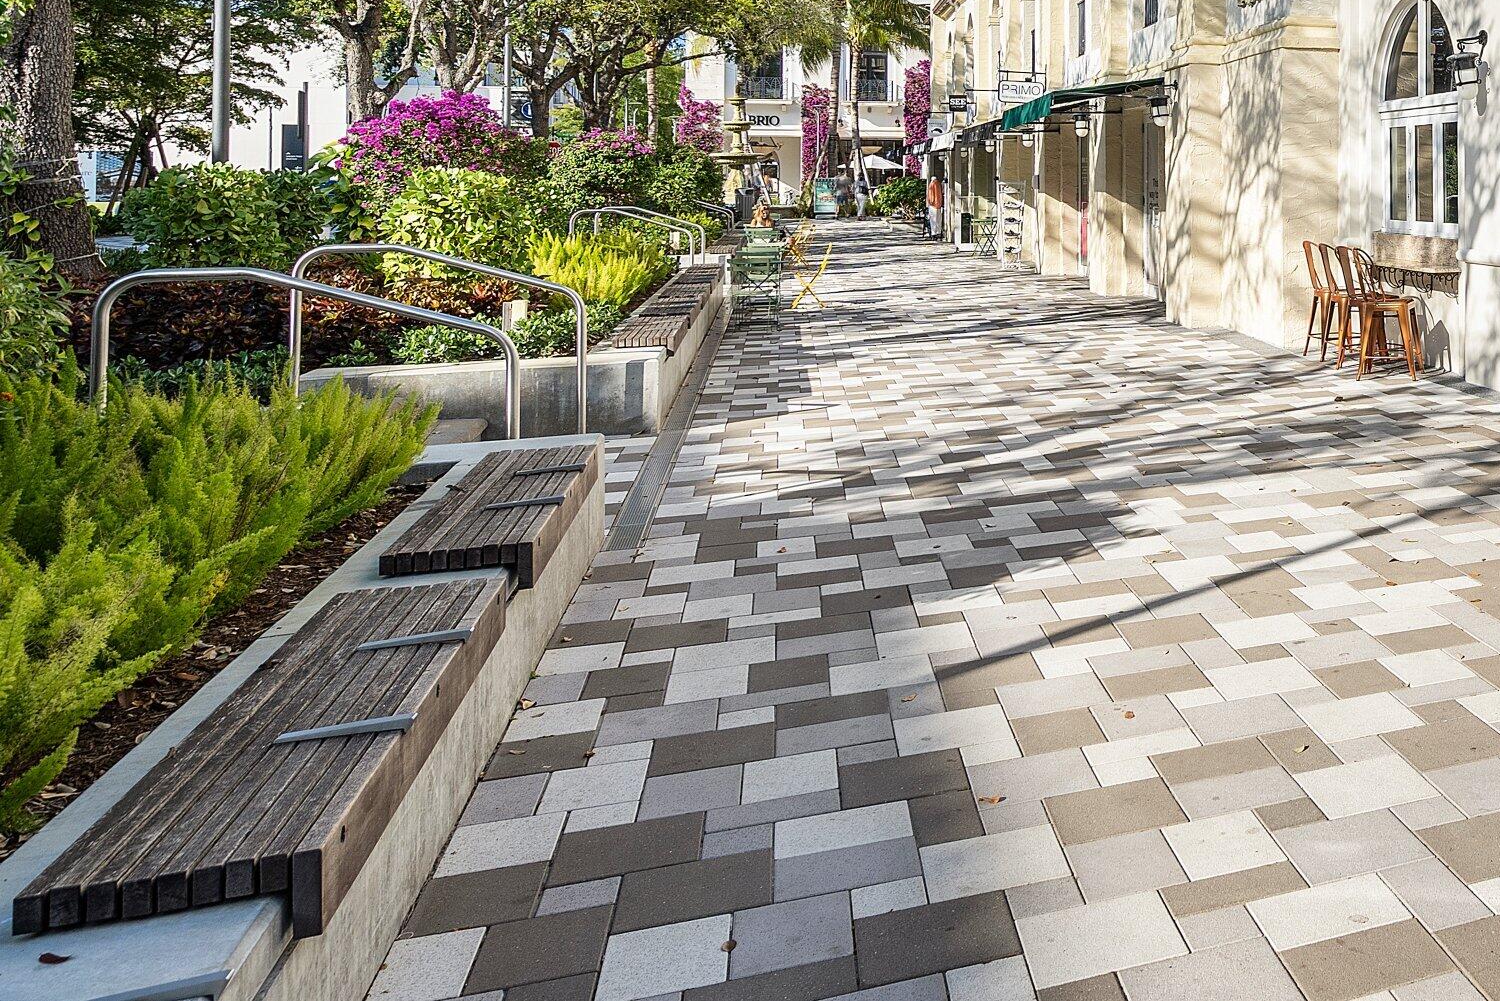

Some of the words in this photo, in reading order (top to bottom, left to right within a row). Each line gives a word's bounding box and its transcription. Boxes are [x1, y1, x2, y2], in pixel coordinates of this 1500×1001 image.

[1001, 84, 1041, 96] PRIMO
[949, 98, 967, 106] SEE
[748, 115, 780, 126] BRIO
